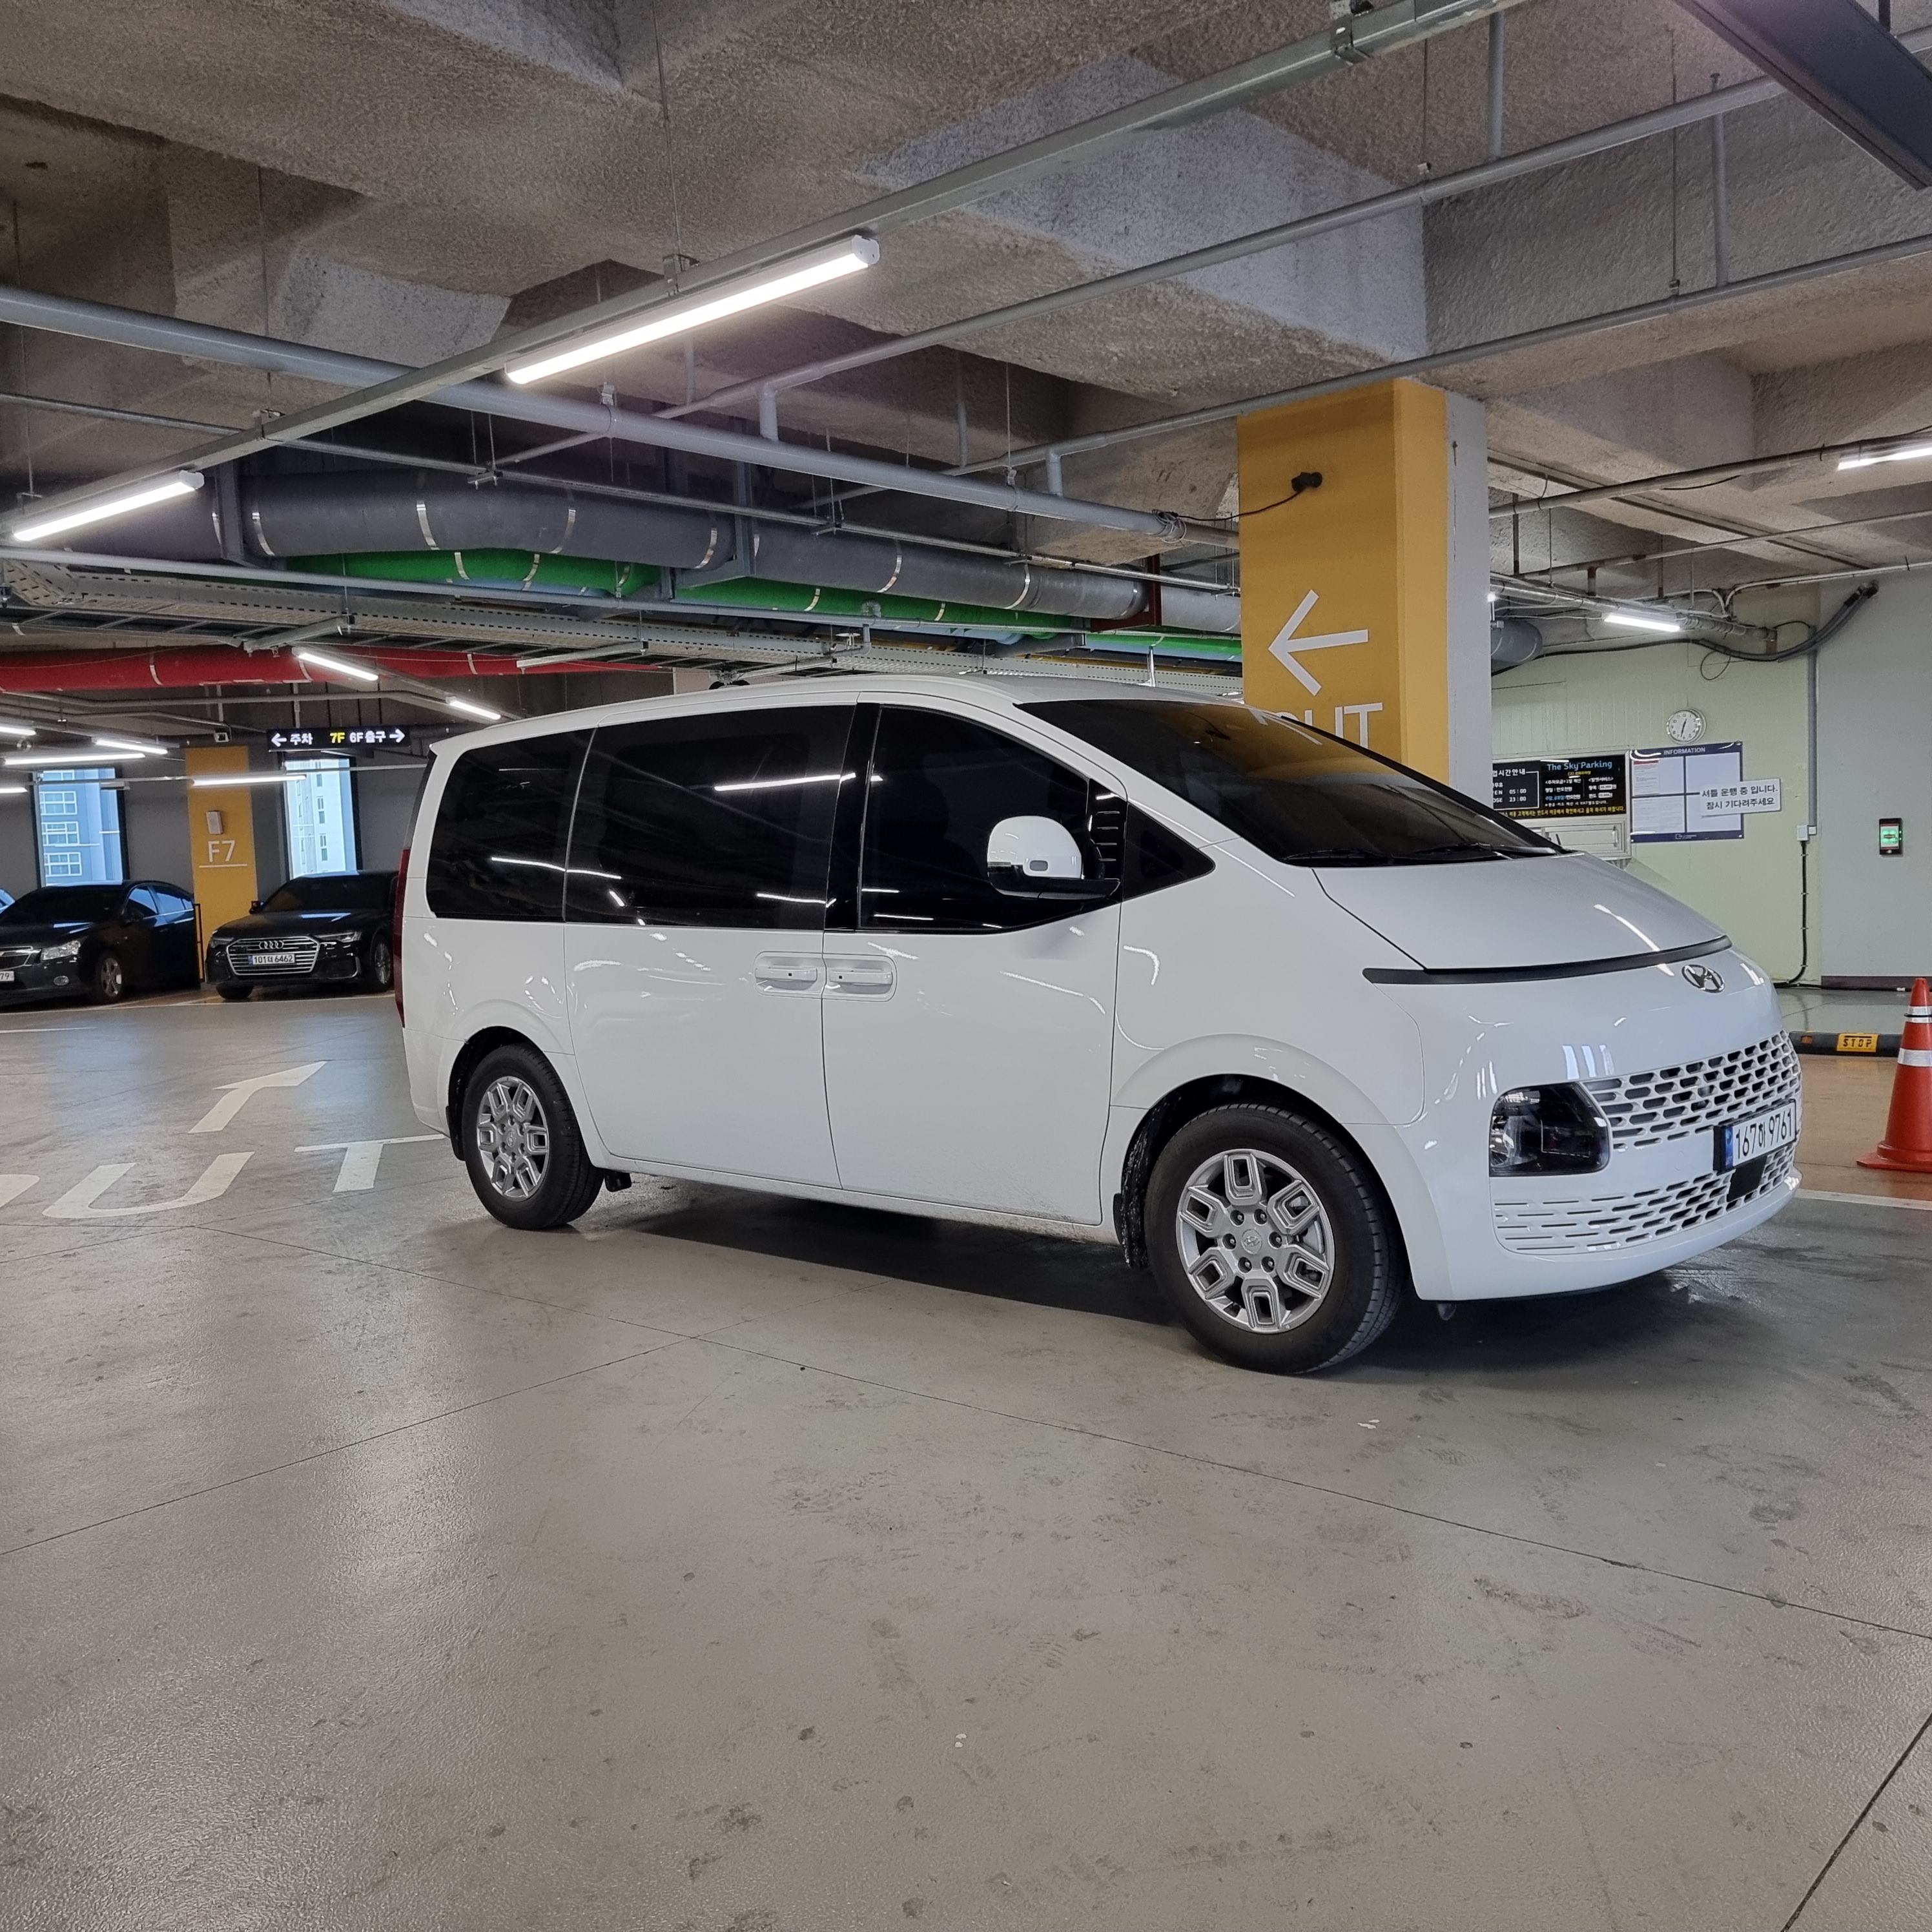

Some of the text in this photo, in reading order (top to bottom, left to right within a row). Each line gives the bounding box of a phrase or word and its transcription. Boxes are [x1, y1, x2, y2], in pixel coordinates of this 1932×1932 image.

[1275, 702, 1383, 750] UT
[290, 733, 313, 746] 주차
[329, 732, 345, 744] 7F
[1663, 746, 1706, 755] INFORMATION
[1564, 763, 1579, 771] Sky
[1581, 761, 1612, 769] Parking
[1701, 785, 1778, 797] 셔틀 운행 중 입니다.
[1706, 797, 1775, 810] 잠시 기다려주세요
[208, 839, 236, 863] F7
[1843, 1038, 1872, 1047] STOP
[0, 1133, 446, 1219] UT
